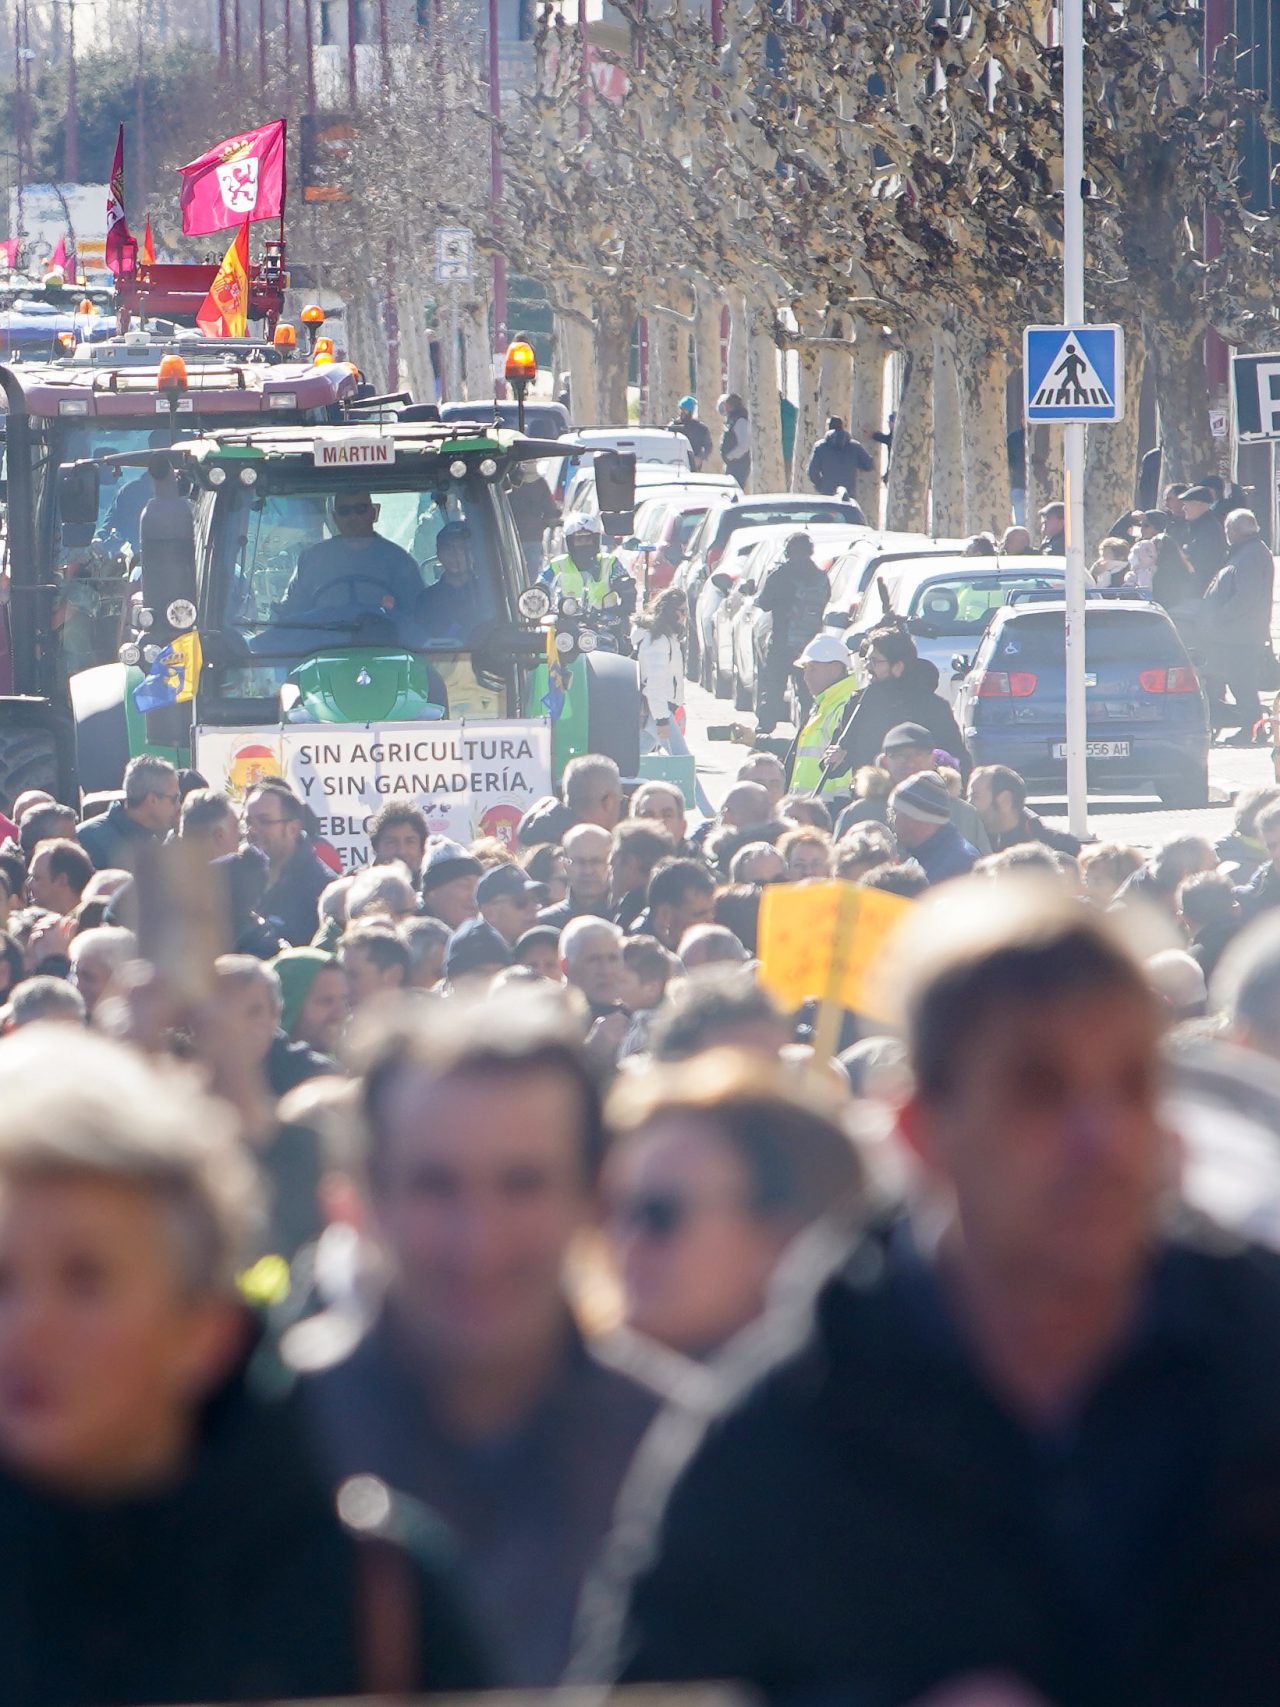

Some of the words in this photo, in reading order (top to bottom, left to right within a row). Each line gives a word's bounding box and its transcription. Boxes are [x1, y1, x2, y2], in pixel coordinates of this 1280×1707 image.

[323, 445, 388, 463] MARTIN
[300, 744, 341, 765] SIN
[350, 739, 534, 763] AGRICULTURA
[1086, 743, 1109, 756] 556
[1113, 743, 1128, 756] AH
[300, 776, 316, 797] Y
[323, 775, 366, 796] SIN
[375, 766, 534, 795] GANADERÍA,
